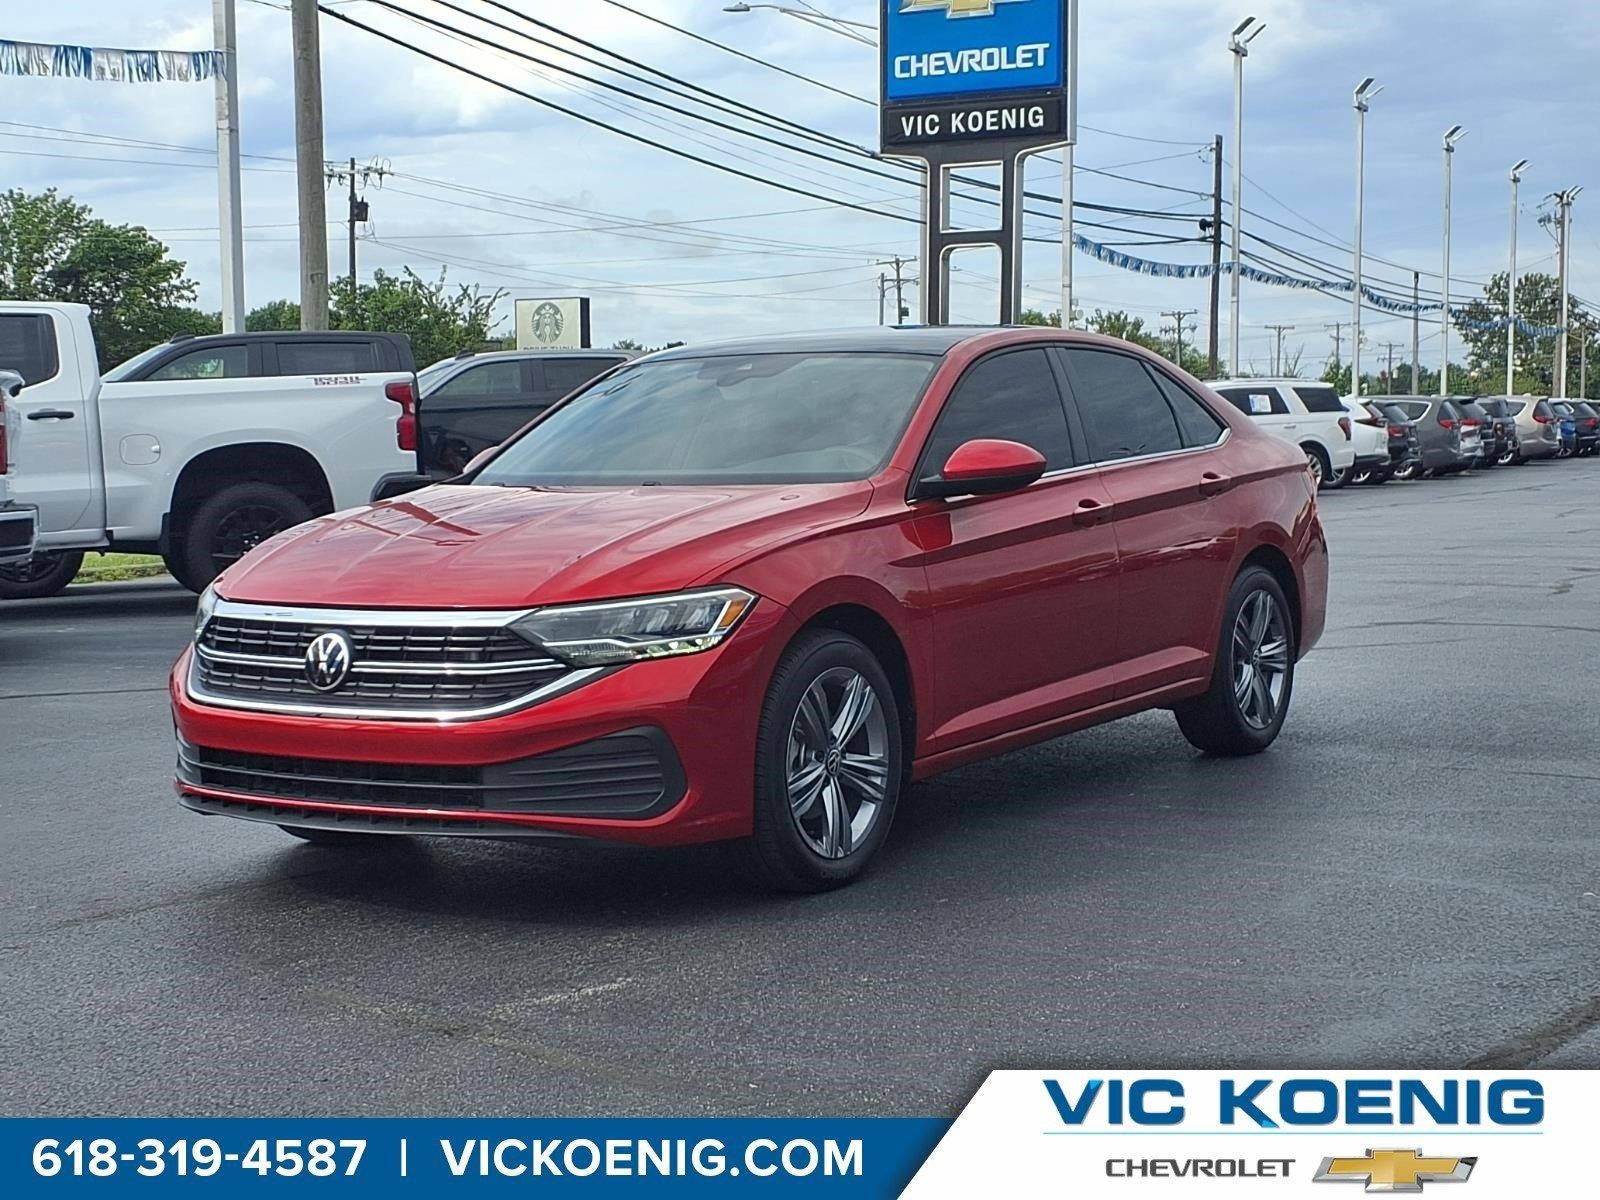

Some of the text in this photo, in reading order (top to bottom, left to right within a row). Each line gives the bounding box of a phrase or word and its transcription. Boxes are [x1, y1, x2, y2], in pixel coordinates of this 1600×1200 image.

[894, 43, 1050, 78] CHEVROLET
[901, 106, 1044, 137] VIC KOENIG
